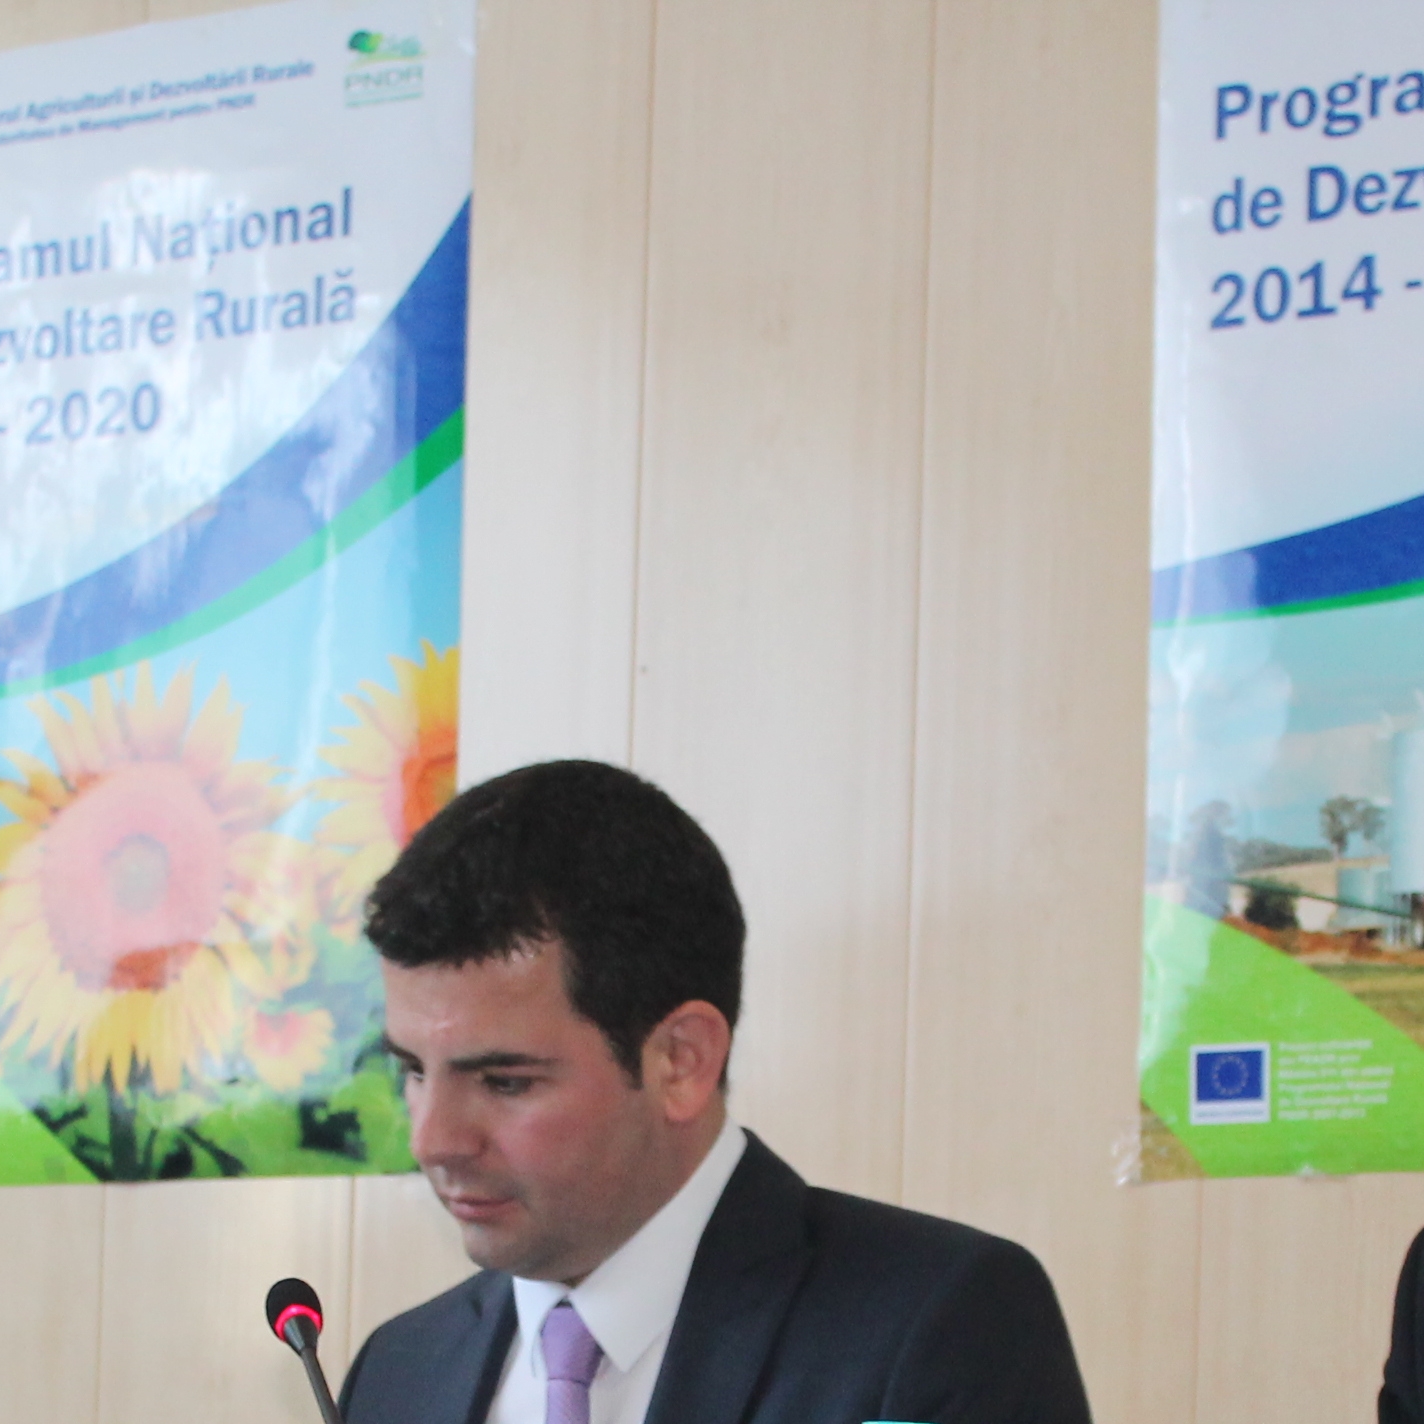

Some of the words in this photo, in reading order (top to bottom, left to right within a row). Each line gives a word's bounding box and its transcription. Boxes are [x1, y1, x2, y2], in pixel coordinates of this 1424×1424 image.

[130, 185, 354, 276] Național
[1211, 177, 1284, 236] de
[194, 271, 358, 344] Rurală
[1209, 253, 1381, 332] 2014
[24, 381, 162, 448] 2020
